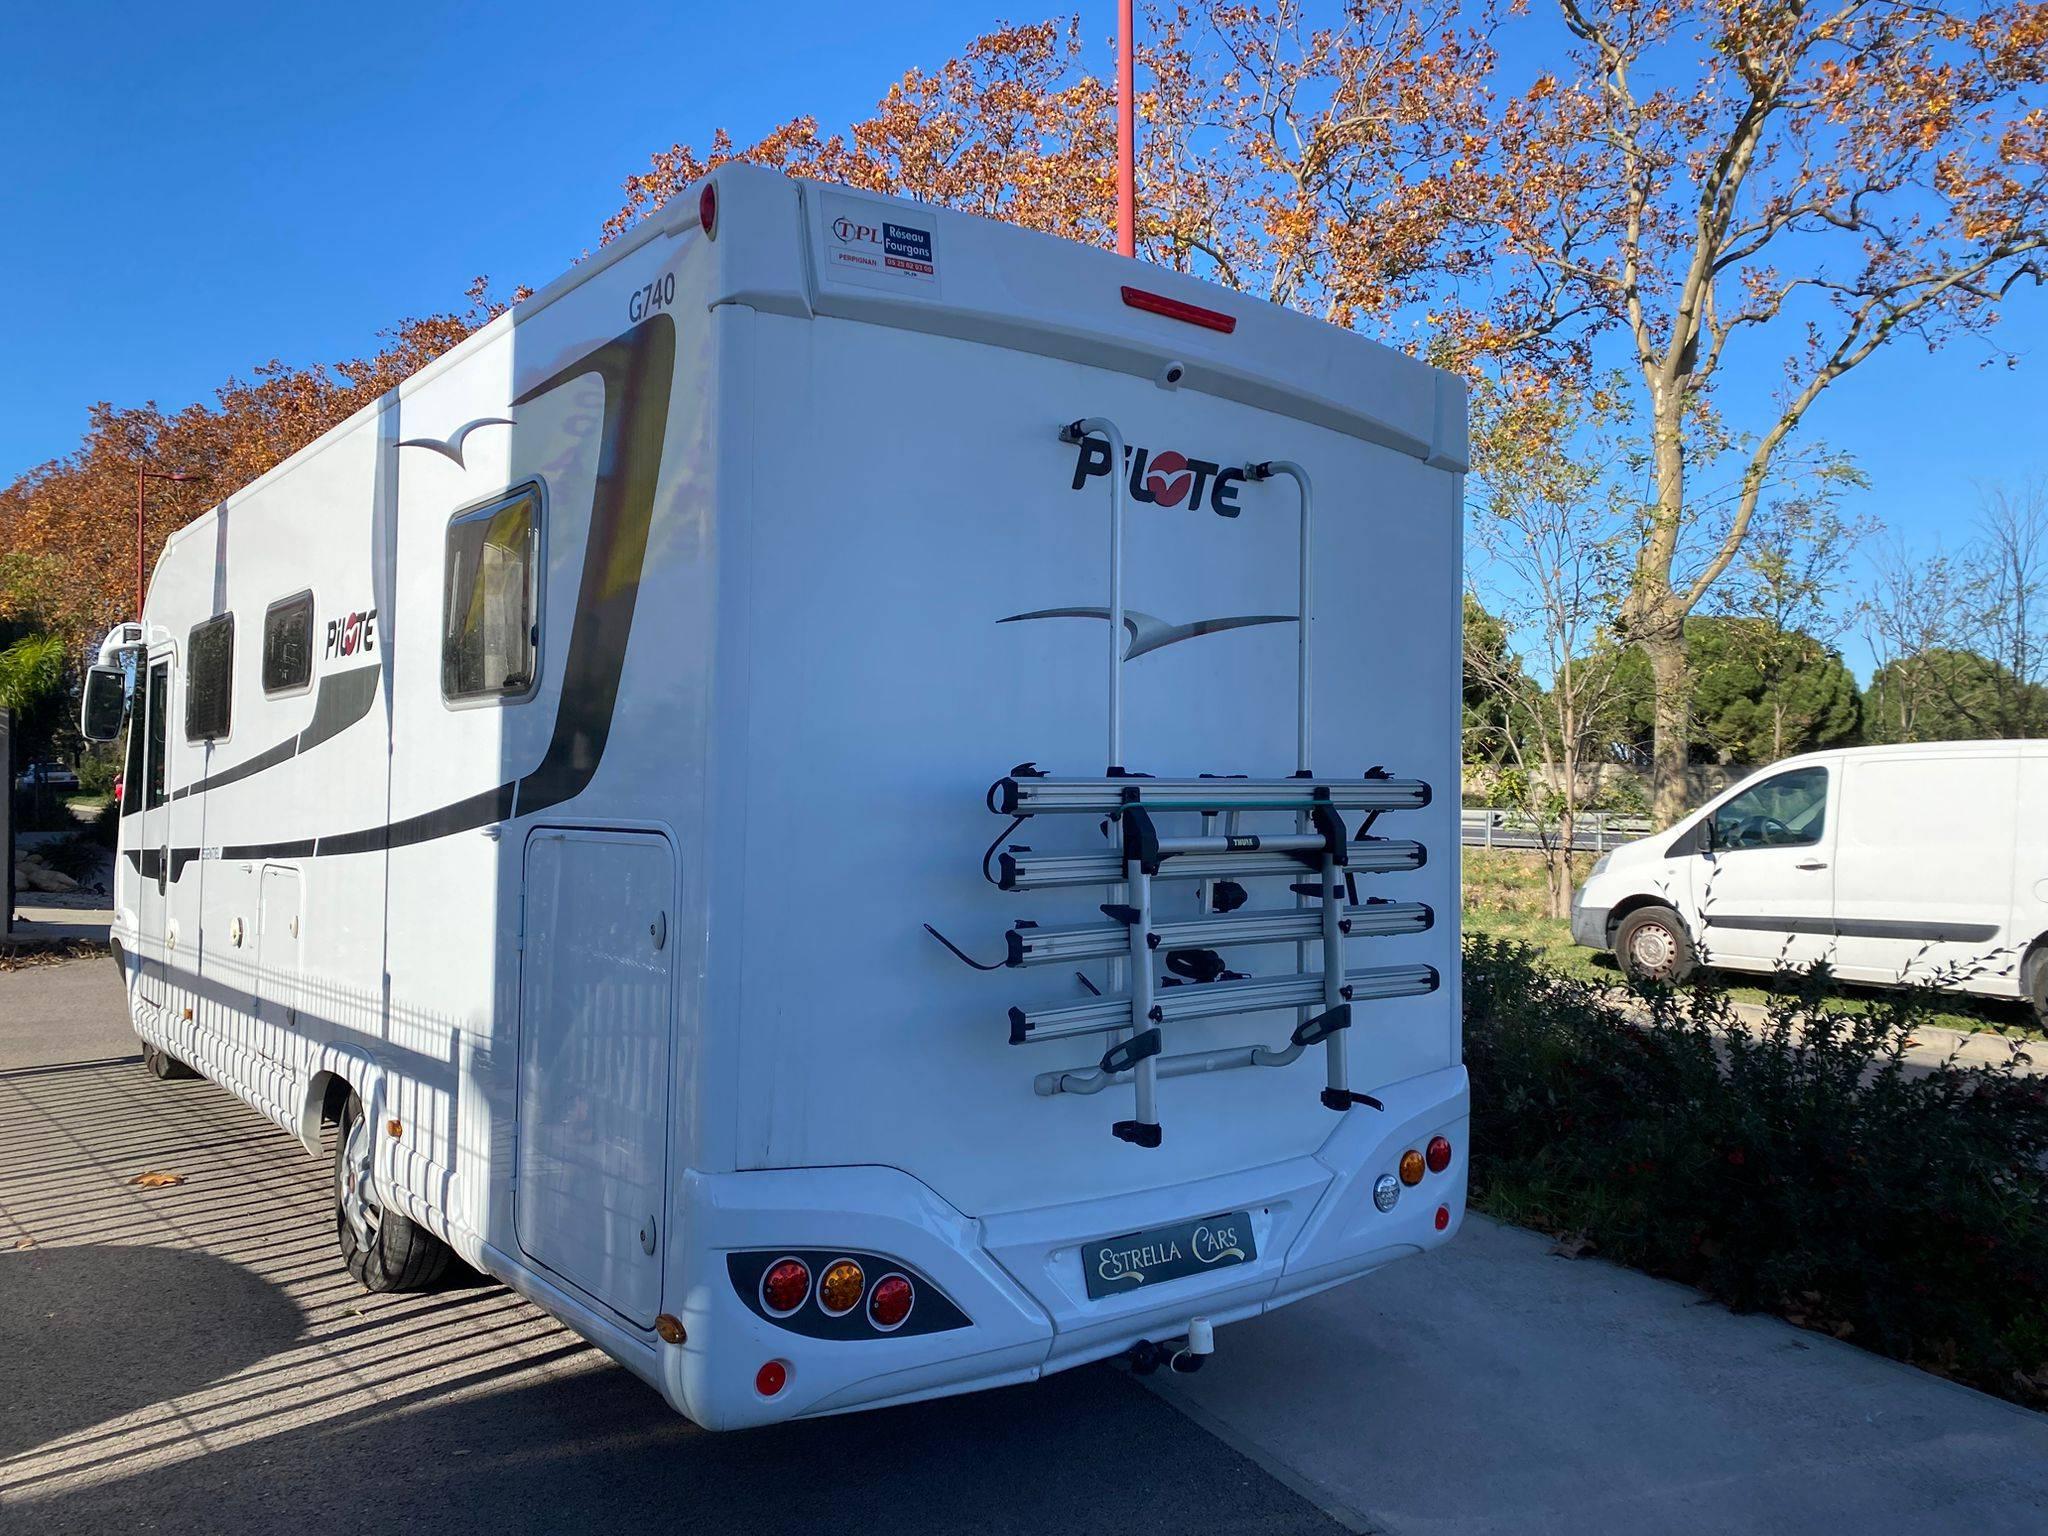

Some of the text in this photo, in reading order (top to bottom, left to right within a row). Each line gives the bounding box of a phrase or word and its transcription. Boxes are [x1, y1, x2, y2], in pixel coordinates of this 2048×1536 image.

[836, 219, 883, 244] TPL
[889, 225, 924, 243] Réseau
[885, 239, 930, 257] Fourgons
[838, 253, 877, 267] PERPIGNAN
[629, 272, 675, 323] G740
